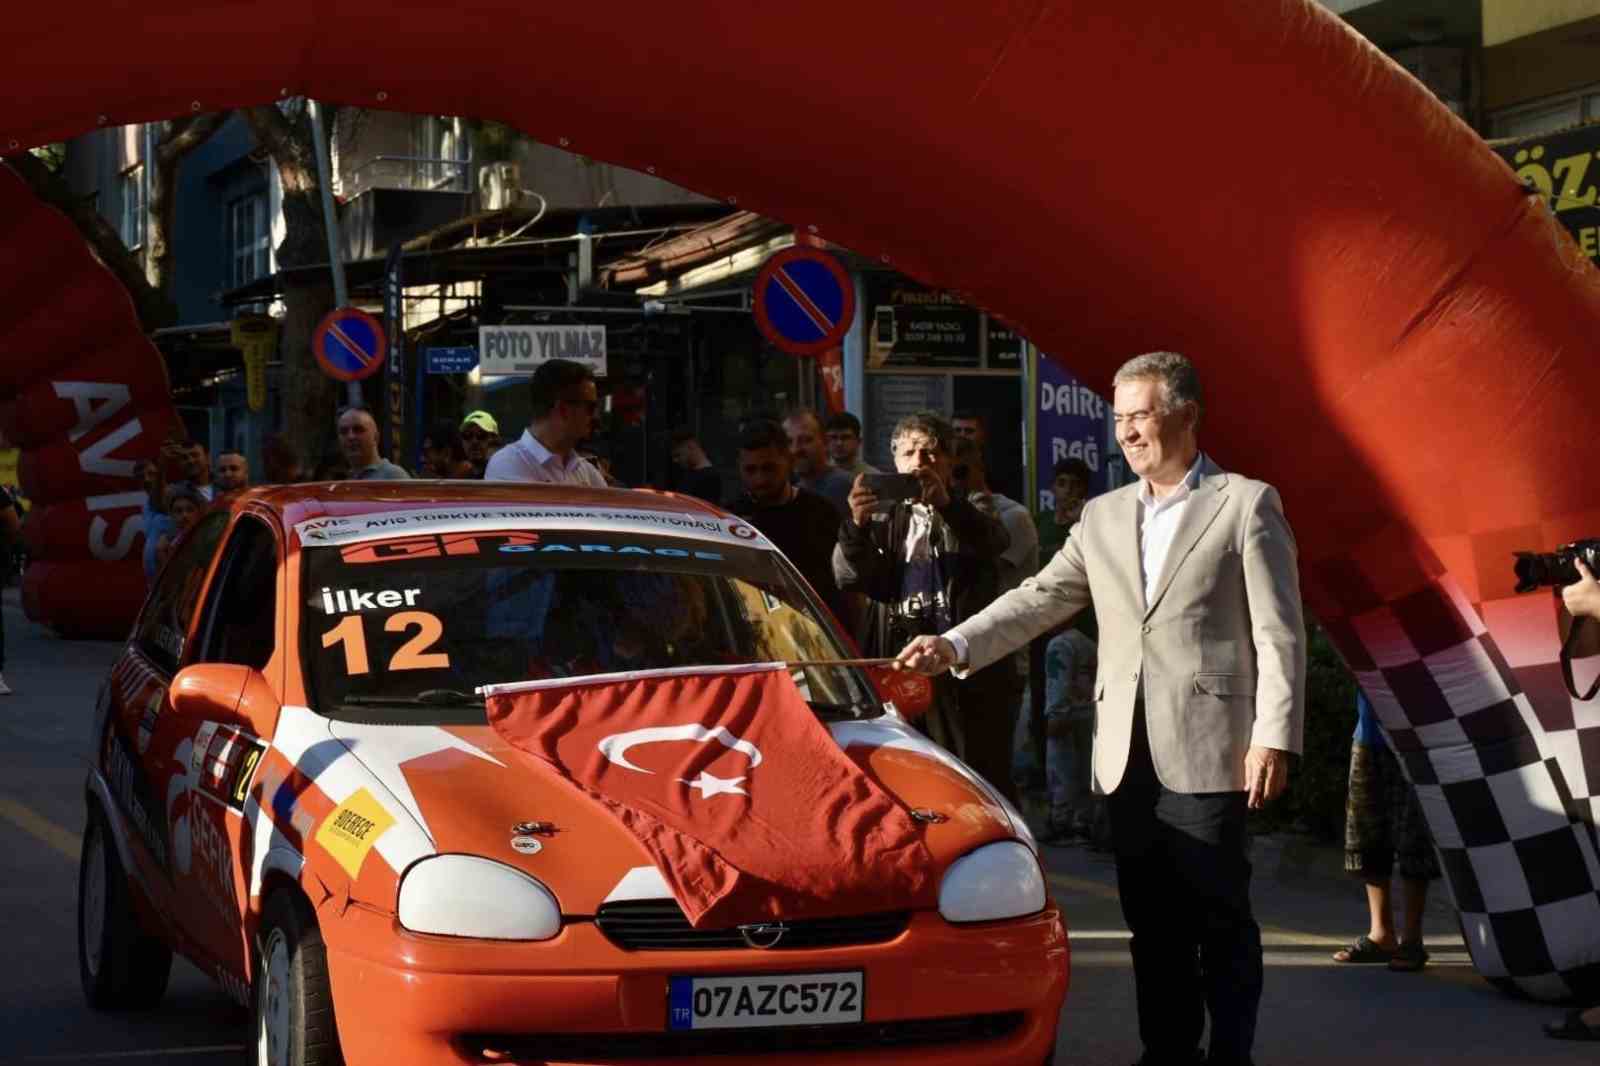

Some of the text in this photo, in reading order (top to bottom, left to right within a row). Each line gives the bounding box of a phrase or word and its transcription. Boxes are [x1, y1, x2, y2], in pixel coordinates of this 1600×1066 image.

[484, 331, 604, 359] FOTO YILMAZ
[303, 519, 351, 532] AVIS
[366, 516, 407, 528] AVIS
[497, 543, 724, 561] GARAGE
[321, 610, 450, 675] 12
[673, 982, 858, 1023] TR 07AZC572
